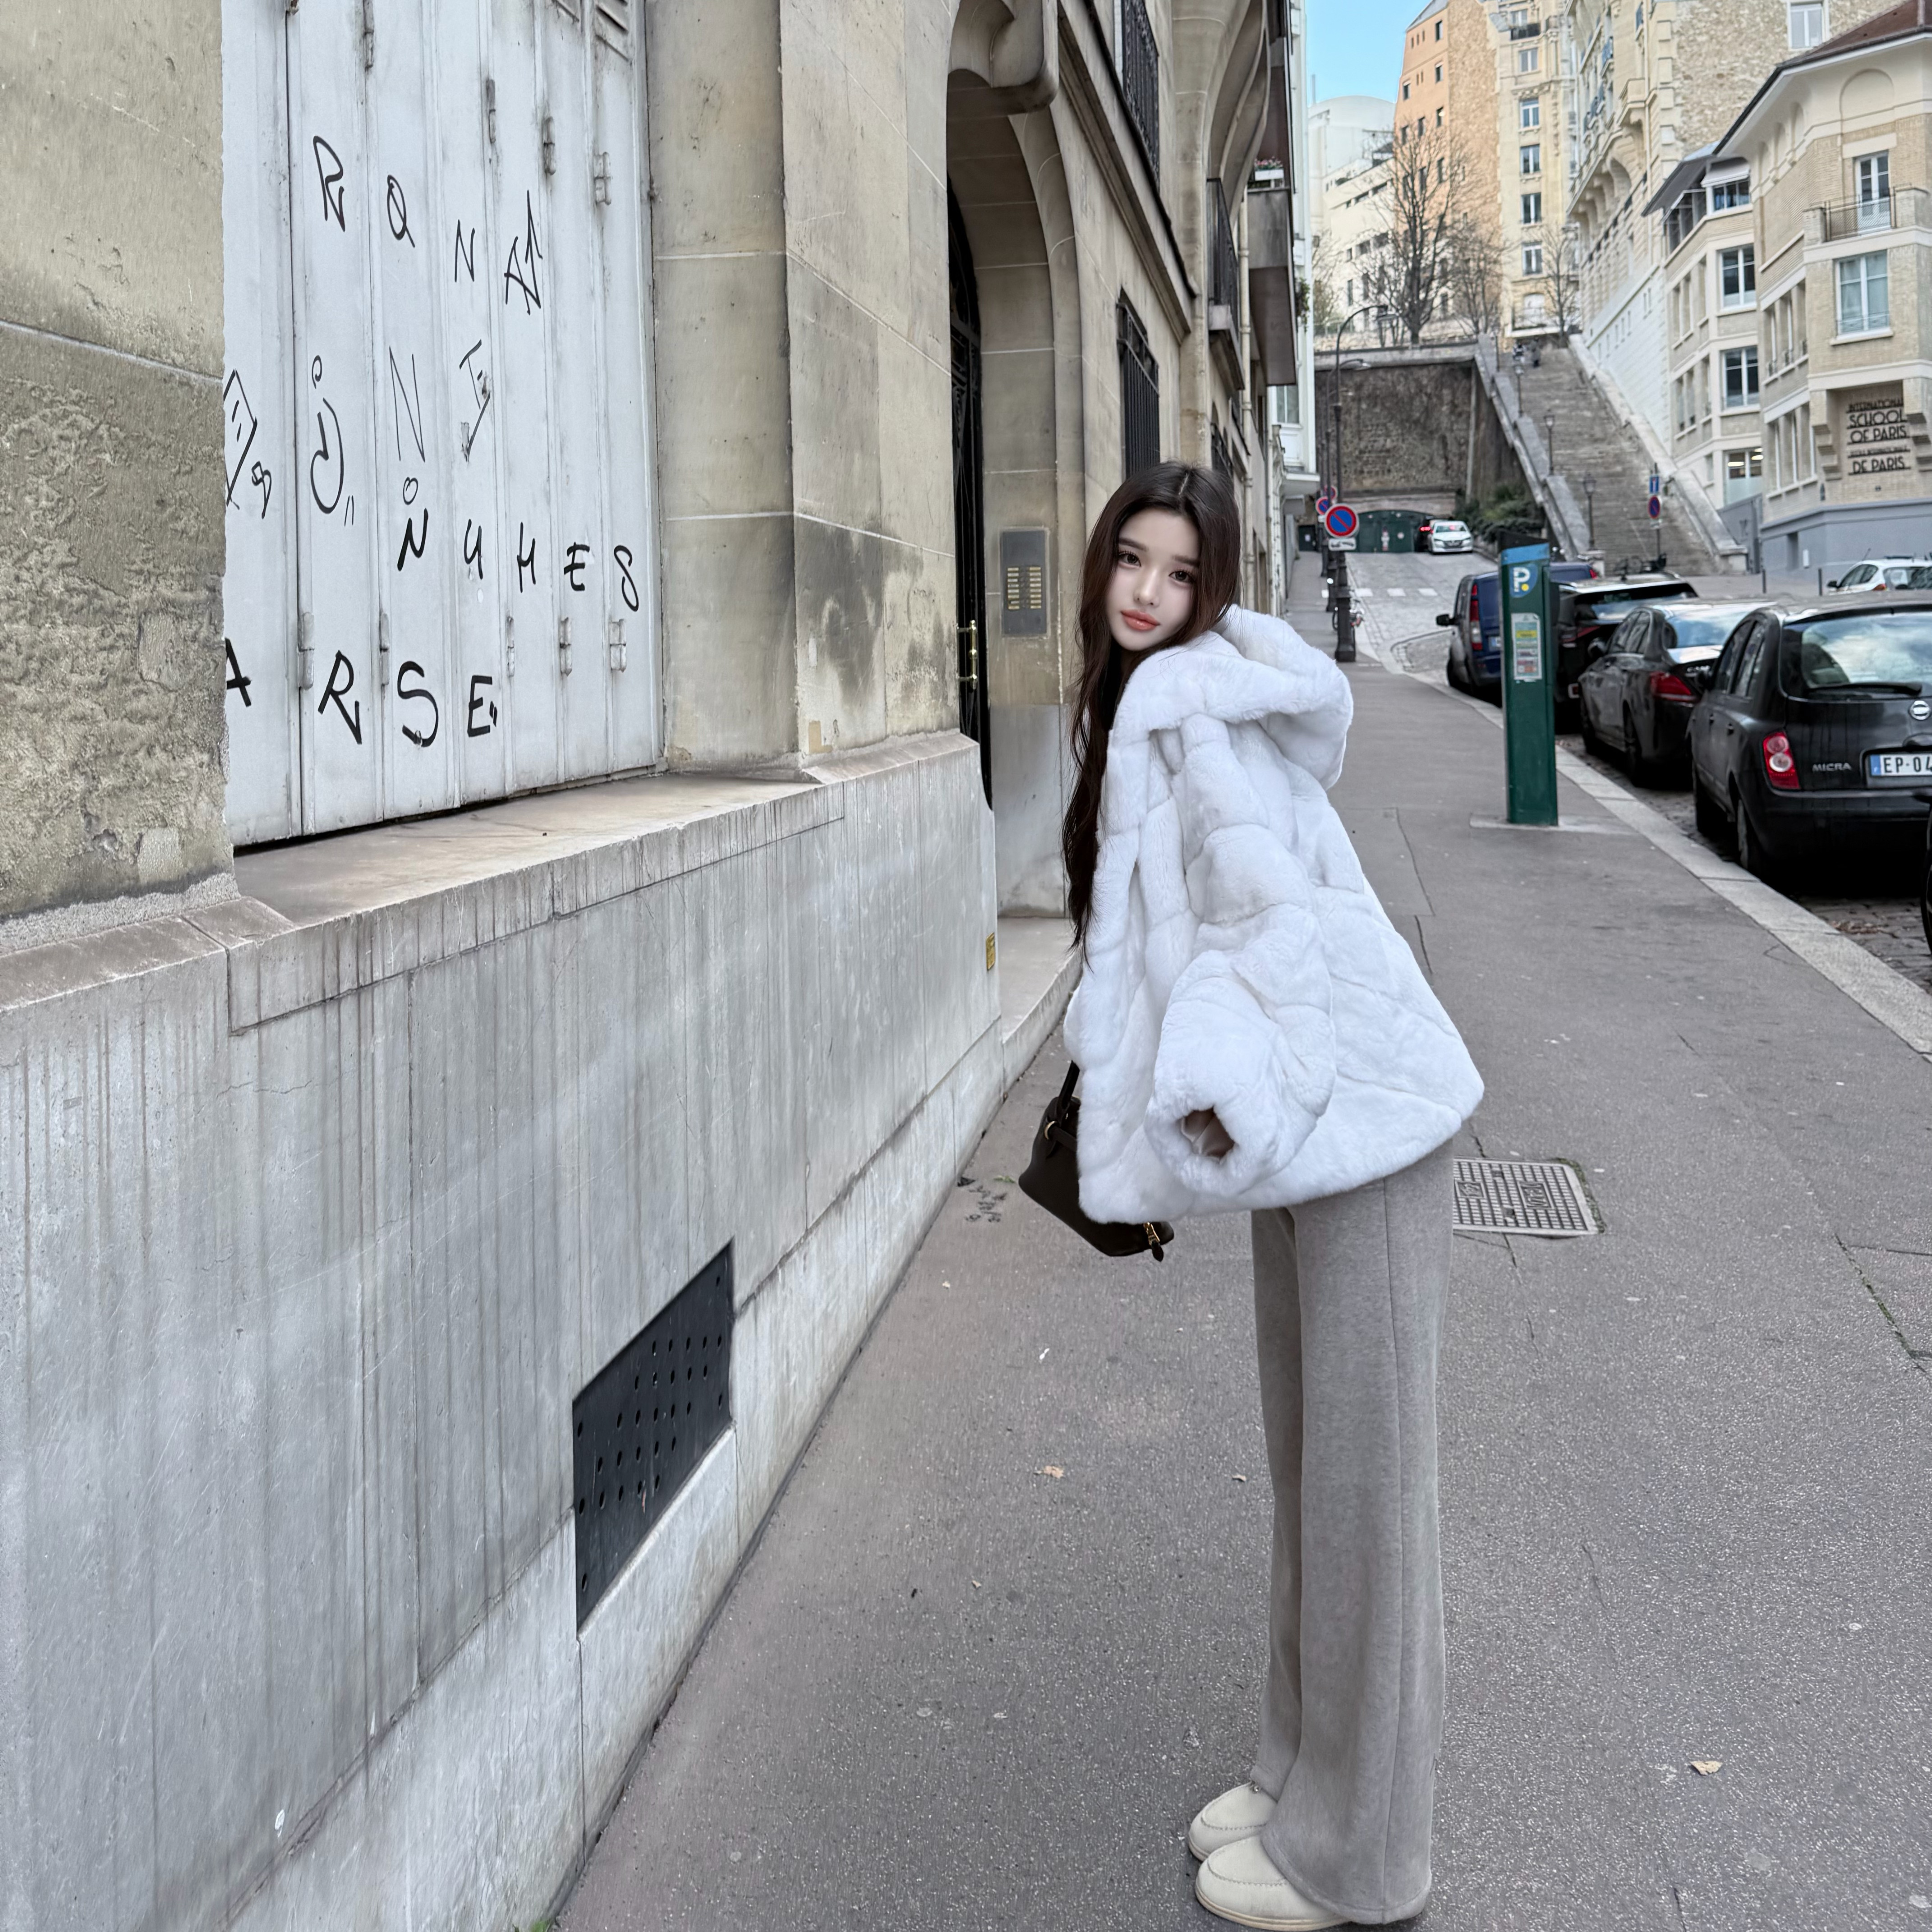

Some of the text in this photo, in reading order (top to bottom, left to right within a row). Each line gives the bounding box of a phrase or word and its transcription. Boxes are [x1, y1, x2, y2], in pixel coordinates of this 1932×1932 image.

[1849, 409, 1908, 428] SCHOOL
[1850, 425, 1907, 444] OF PARIS
[1852, 456, 1905, 474] DE PARIS
[1513, 566, 1531, 592] P
[1812, 762, 1852, 771] MICRA
